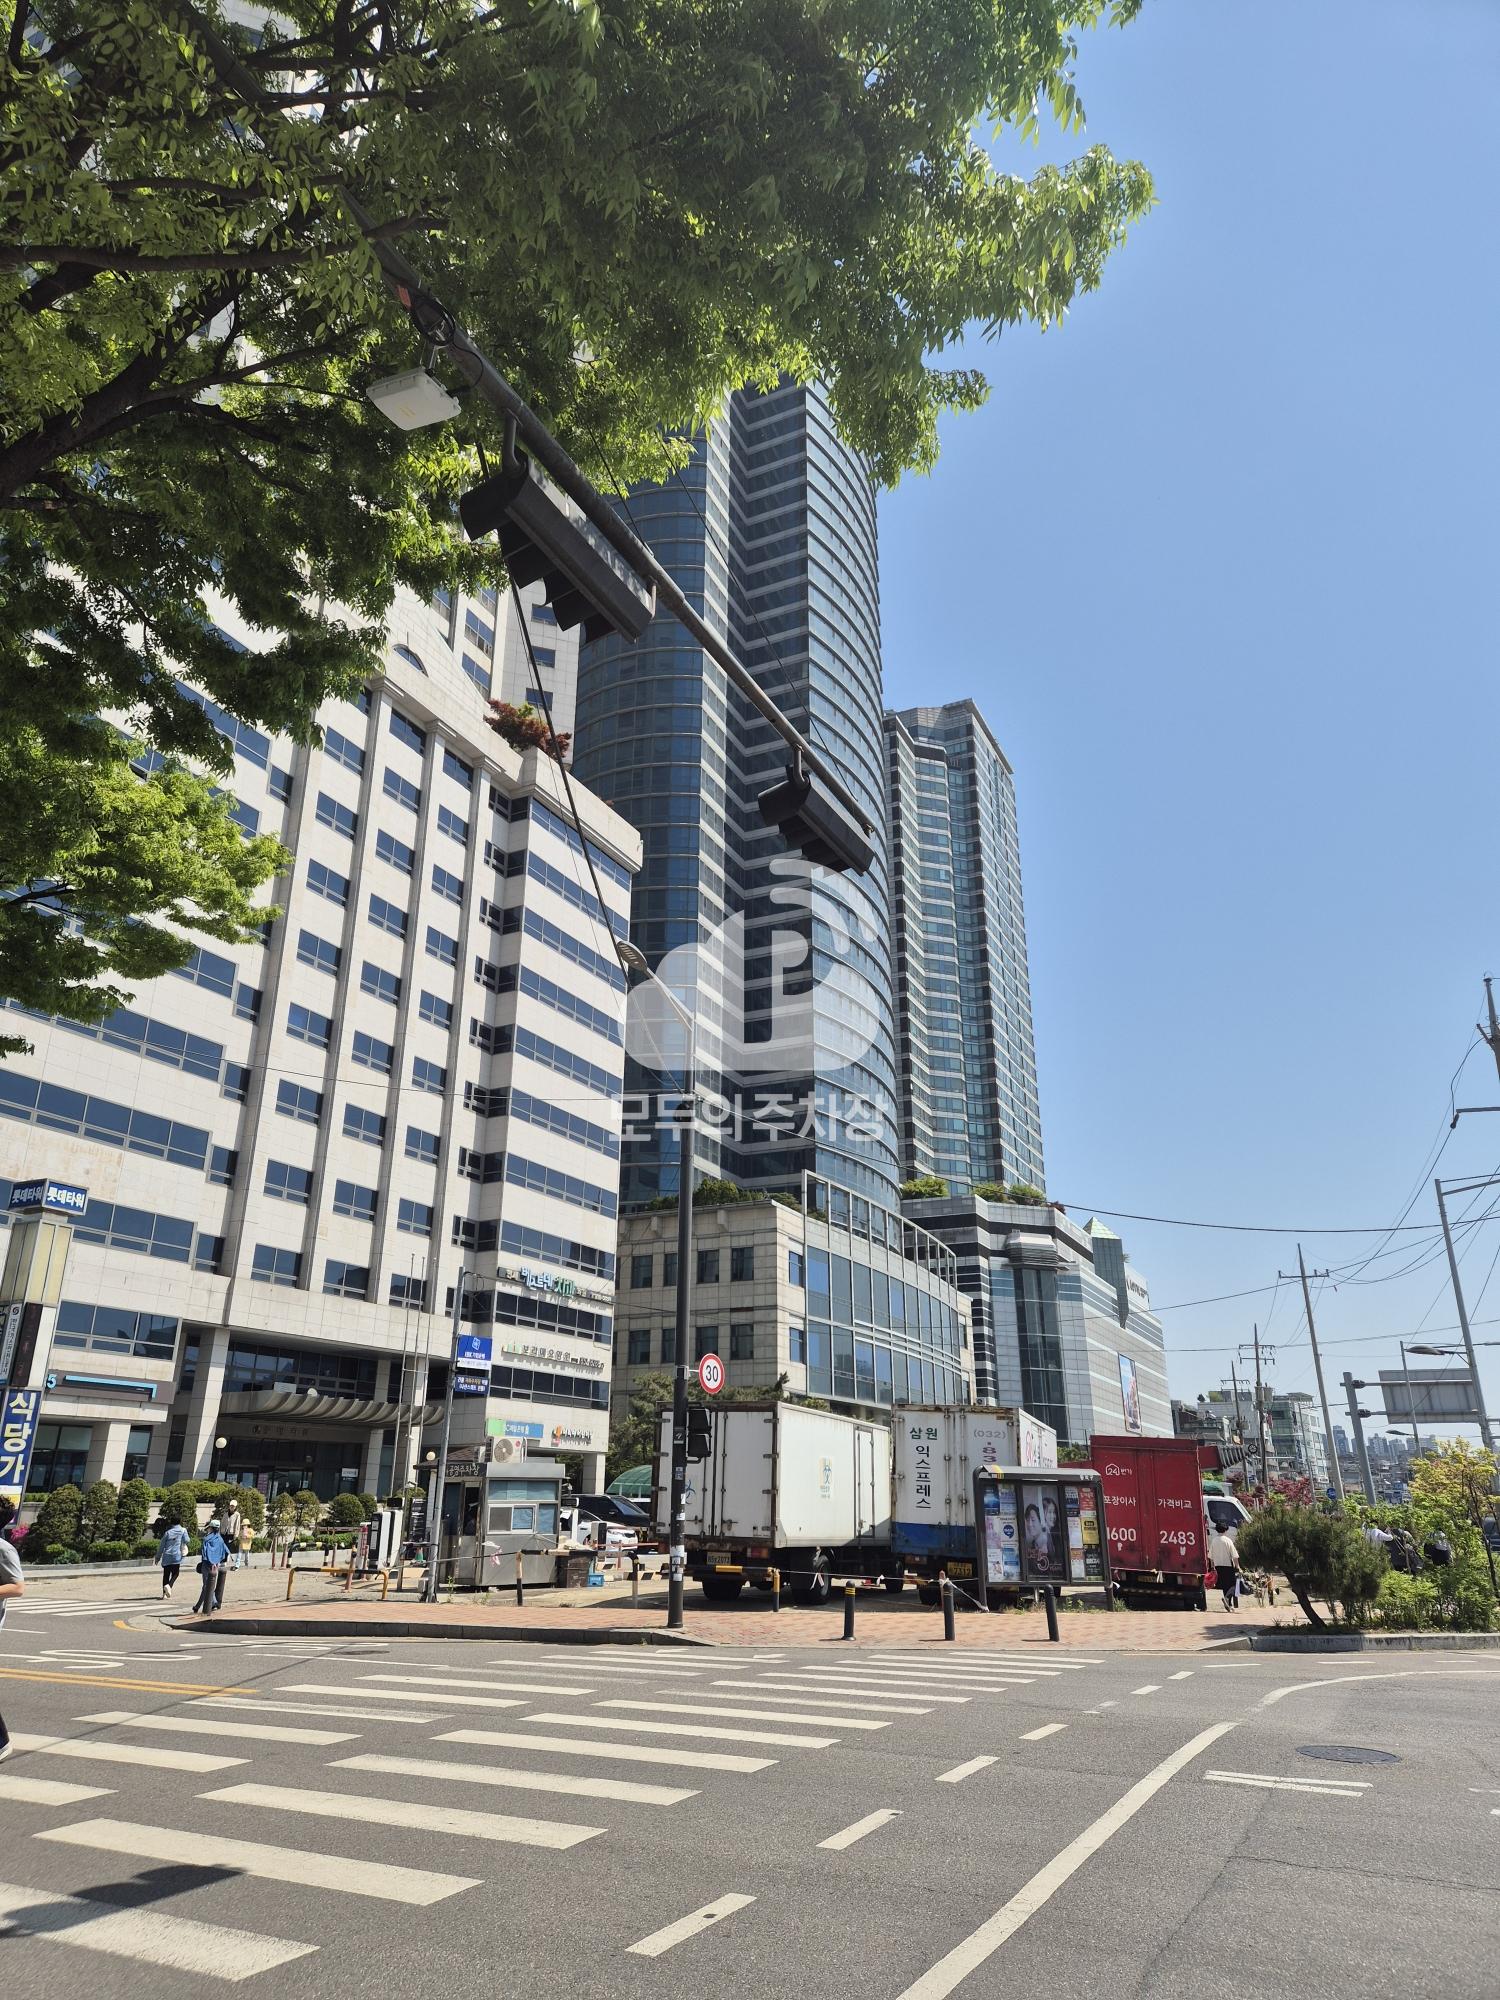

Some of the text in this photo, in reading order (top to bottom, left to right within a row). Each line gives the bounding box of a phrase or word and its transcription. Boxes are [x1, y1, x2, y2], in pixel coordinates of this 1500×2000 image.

[47, 1186, 85, 1208] 롯데타워
[705, 1364, 719, 1382] 30
[0, 1392, 37, 1484] 식당가
[909, 1427, 938, 1441] 삼원
[973, 1429, 1007, 1440] (032)
[915, 1445, 932, 1510] 익스프레스
[1103, 1495, 1137, 1507] 포장이사
[1158, 1498, 1193, 1510] 가격비교
[1106, 1527, 1137, 1542] 1600
[1159, 1530, 1196, 1546] 2483
